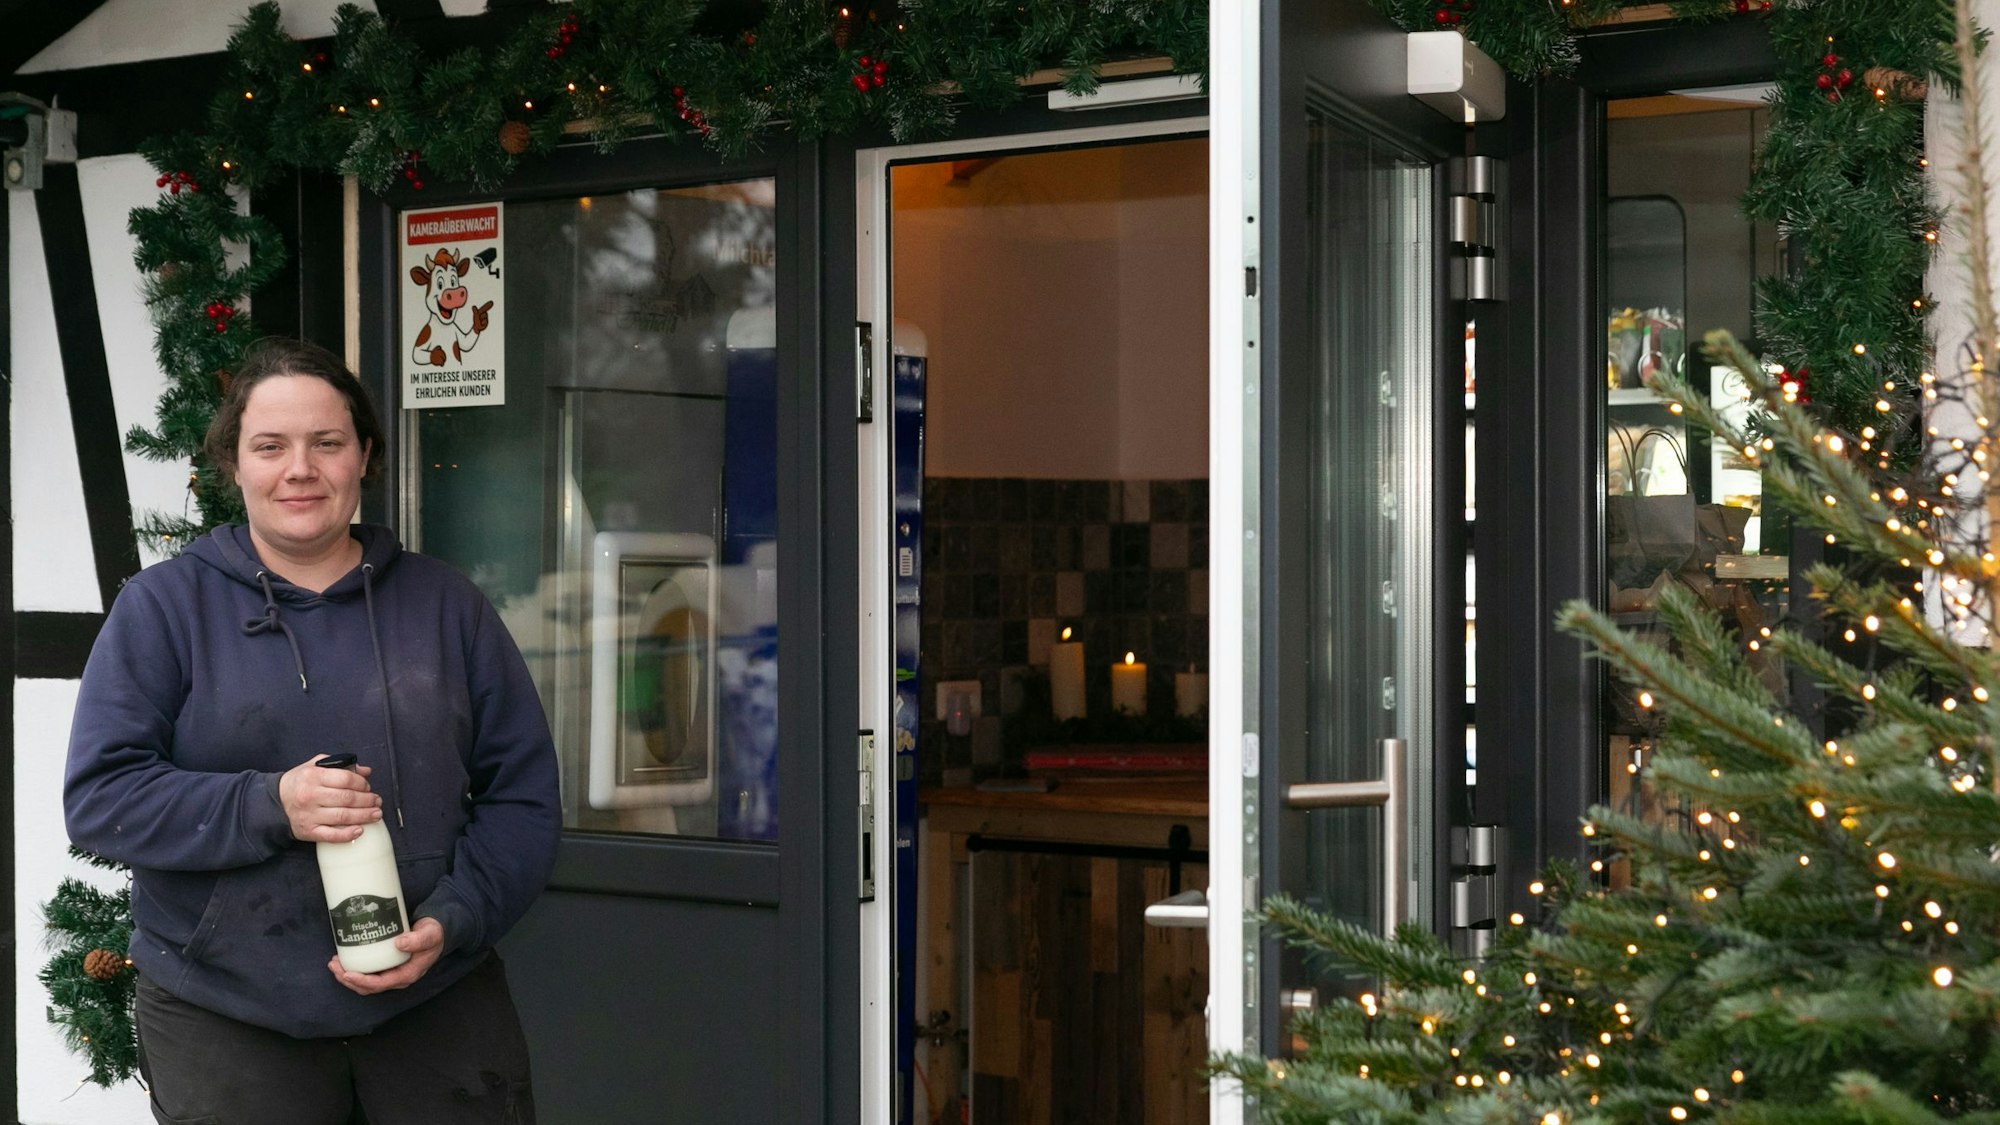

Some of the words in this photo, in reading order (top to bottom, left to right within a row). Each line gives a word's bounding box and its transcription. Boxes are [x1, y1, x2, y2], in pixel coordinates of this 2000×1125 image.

[409, 216, 496, 237] KAMERAÜBERWACHT
[410, 373, 420, 384] IM
[421, 371, 460, 383] INTERESSE
[461, 369, 496, 381] UNSERER
[415, 386, 457, 399] EHRLICHEN
[459, 384, 491, 397] KUNDEN
[337, 921, 398, 942] Landmilch
[351, 921, 379, 931] frische
